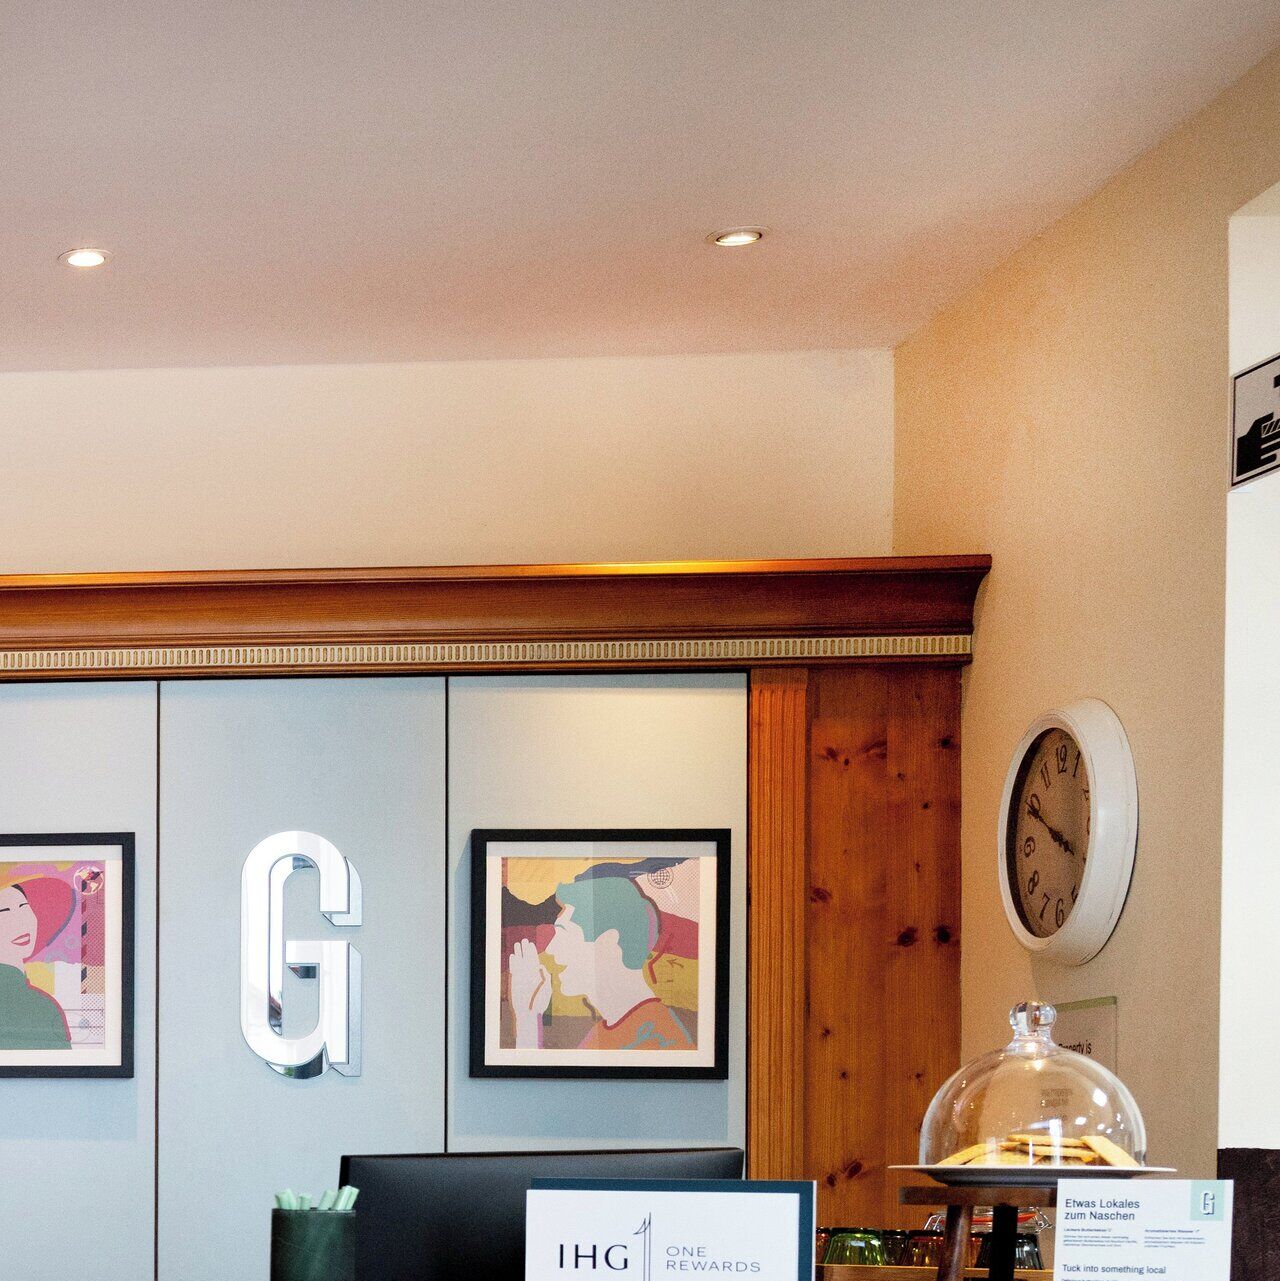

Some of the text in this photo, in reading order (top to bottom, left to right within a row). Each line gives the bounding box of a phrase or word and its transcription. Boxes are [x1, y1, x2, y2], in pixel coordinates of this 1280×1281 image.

[1056, 744, 1068, 775] 12
[1072, 751, 1081, 778] 1
[1027, 870, 1040, 896] 8
[1039, 892, 1050, 922] 7
[1055, 898, 1065, 928] 6
[241, 831, 354, 1070] G
[1064, 1211, 1135, 1221] zum Naschen
[1065, 1198, 1140, 1209] Etwas Lokales
[559, 1243, 629, 1271] IHG
[666, 1246, 707, 1258] ONE
[666, 1259, 761, 1273] REWARDS
[1062, 1264, 1166, 1275] Tuck into something local
